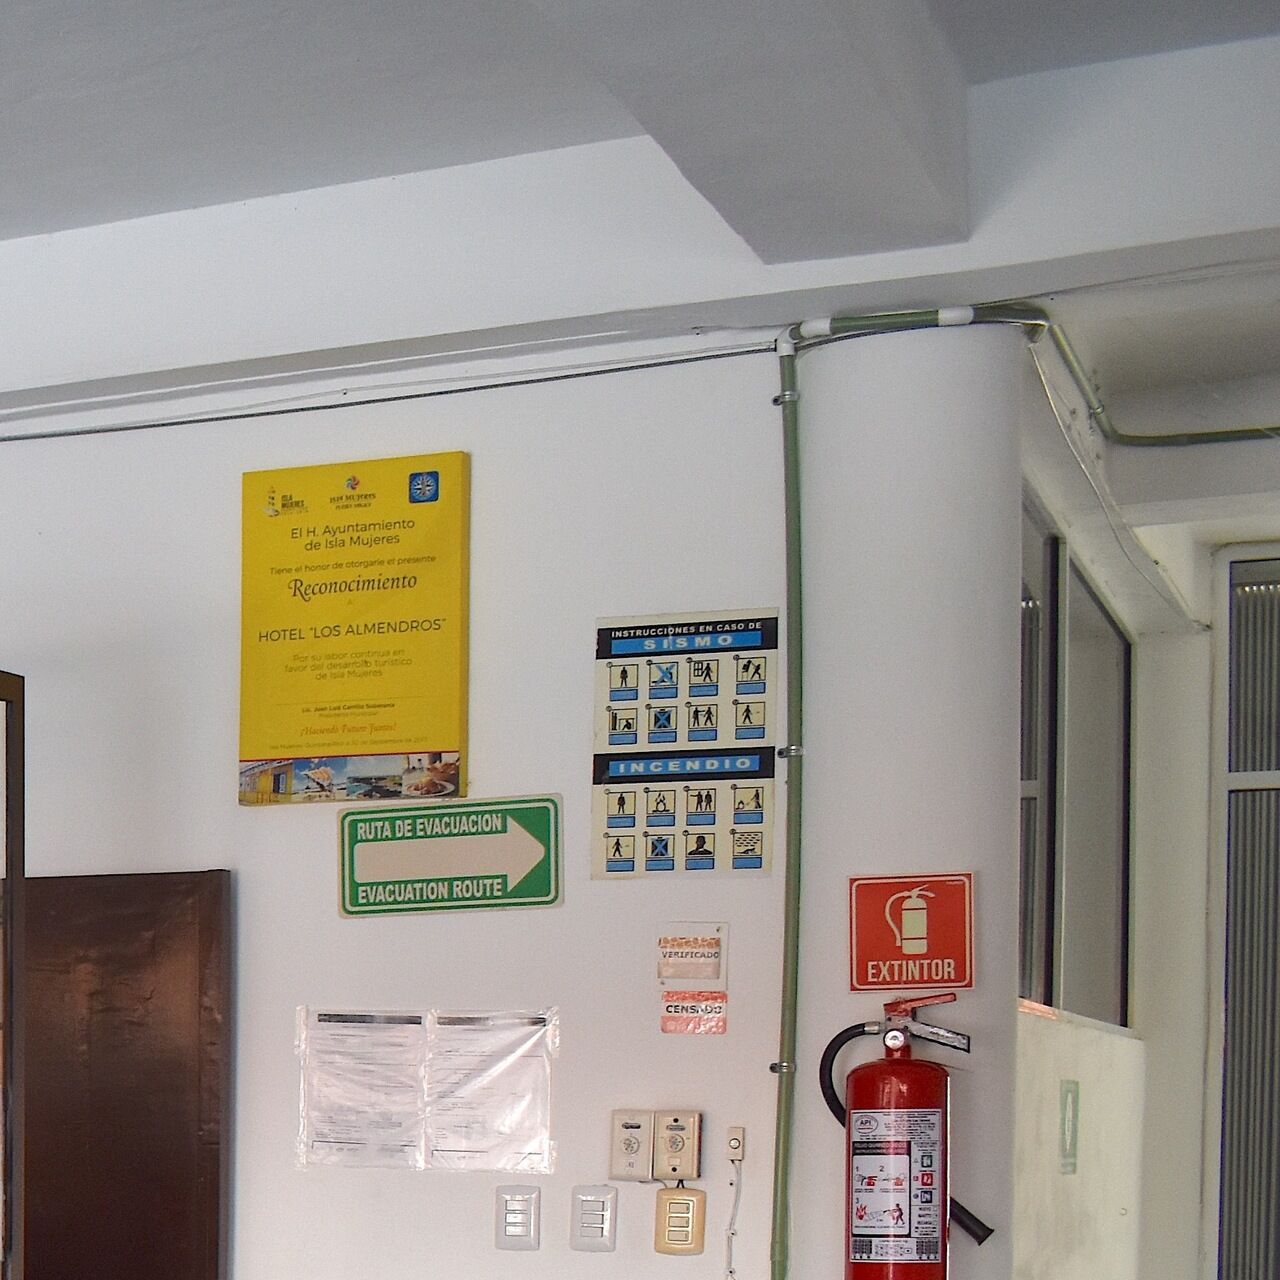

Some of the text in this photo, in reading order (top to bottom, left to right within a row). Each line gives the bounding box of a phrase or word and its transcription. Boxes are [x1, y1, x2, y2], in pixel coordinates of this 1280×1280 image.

[291, 519, 415, 539] El H. Ayuntamiento
[305, 534, 400, 551] de Isla Mujeres
[270, 567, 292, 576] Tiene
[305, 564, 330, 572] honor
[332, 562, 343, 570] de
[398, 556, 436, 566] presente
[288, 572, 418, 601] Reconocimiento
[259, 629, 304, 642] HOTEL
[612, 626, 695, 638] INSTRUCCIONES
[717, 622, 744, 632] CASO
[749, 621, 762, 629] DE
[644, 635, 732, 650] SISMO
[348, 670, 382, 679] Mujeres
[619, 758, 751, 773] INCENDIO
[358, 814, 502, 840] RUTA DE EVACUACION
[358, 878, 502, 904] EVACUATION ROUTE
[867, 959, 955, 982] EXTINTOR
[666, 1005, 722, 1014] CENSADO
